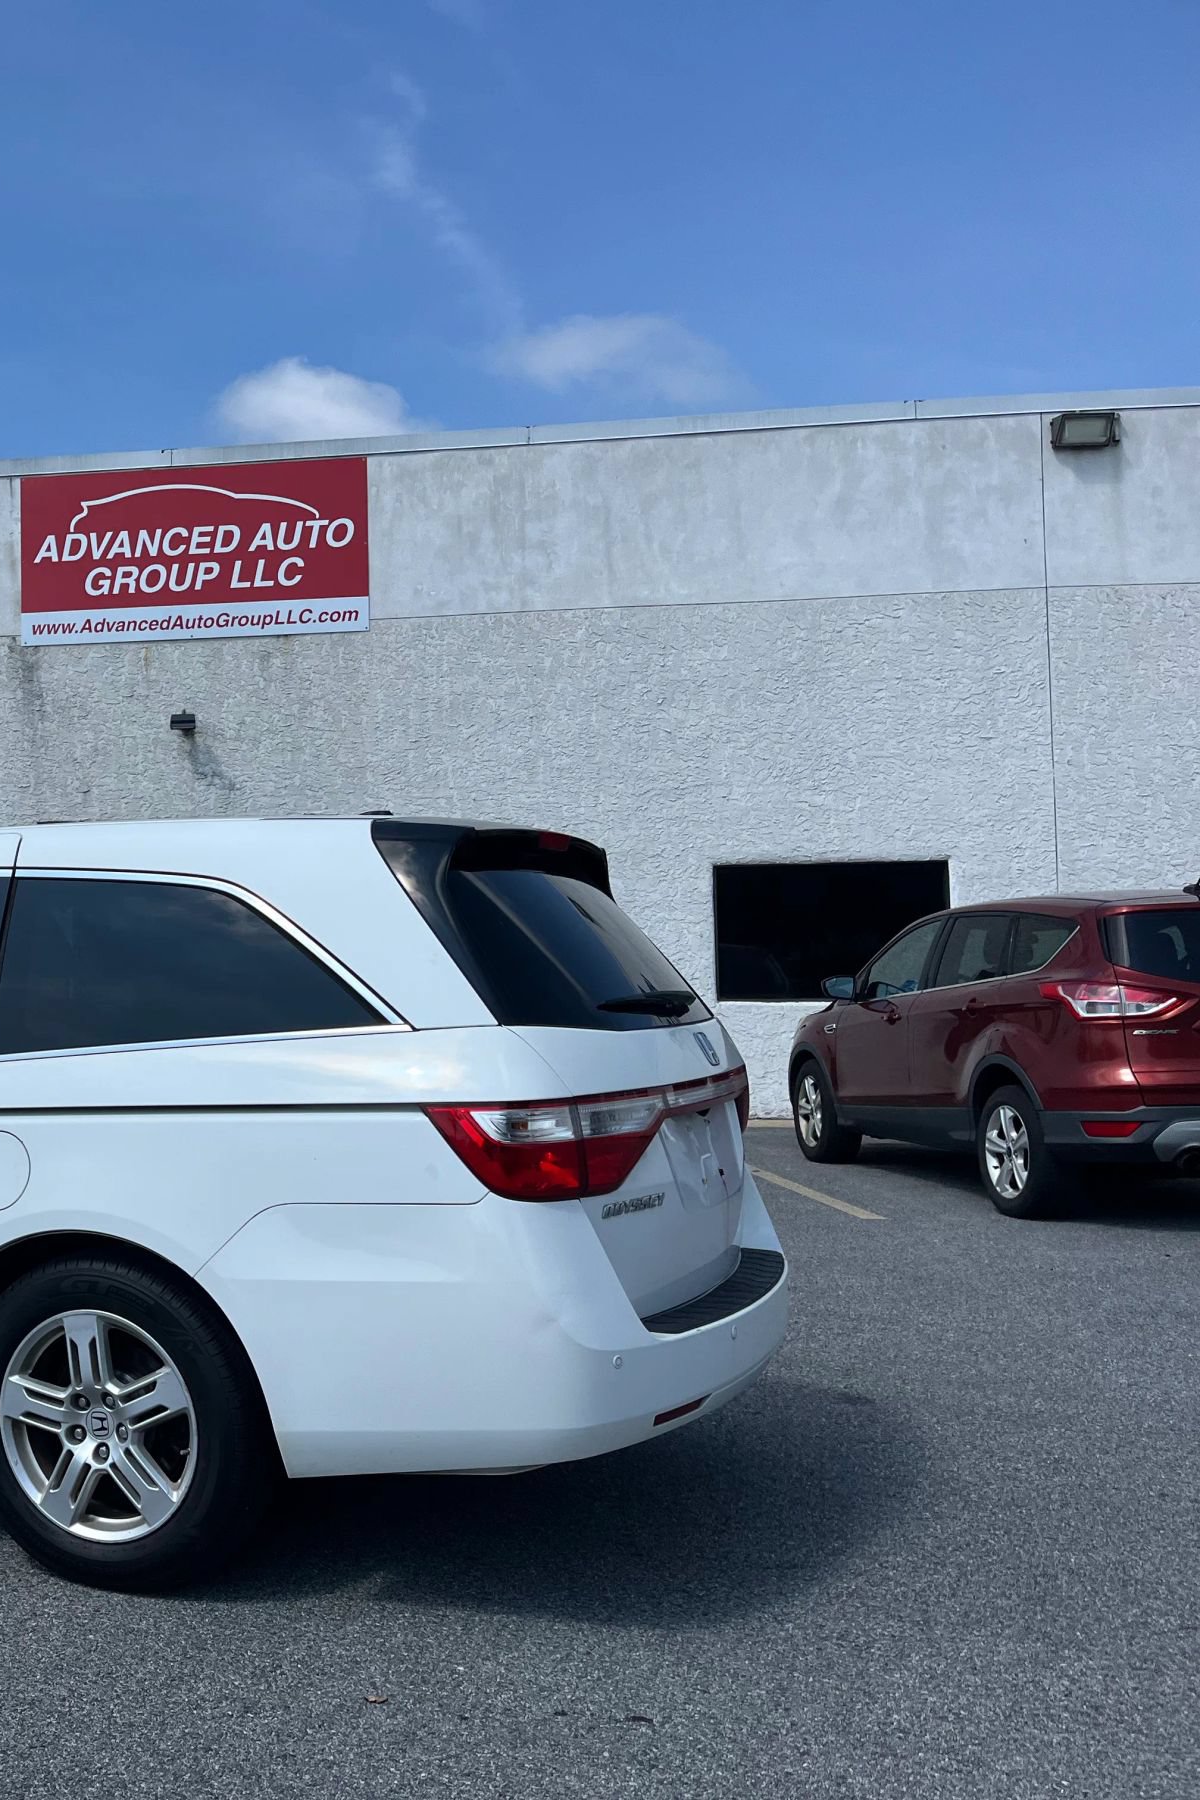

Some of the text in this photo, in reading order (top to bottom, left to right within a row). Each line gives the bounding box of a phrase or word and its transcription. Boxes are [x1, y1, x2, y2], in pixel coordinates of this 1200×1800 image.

[33, 517, 355, 564] ADVANCED AUTO
[84, 556, 305, 597] GROUP LLC
[31, 608, 359, 636] www.AdvancedAutoGroupLLC.com
